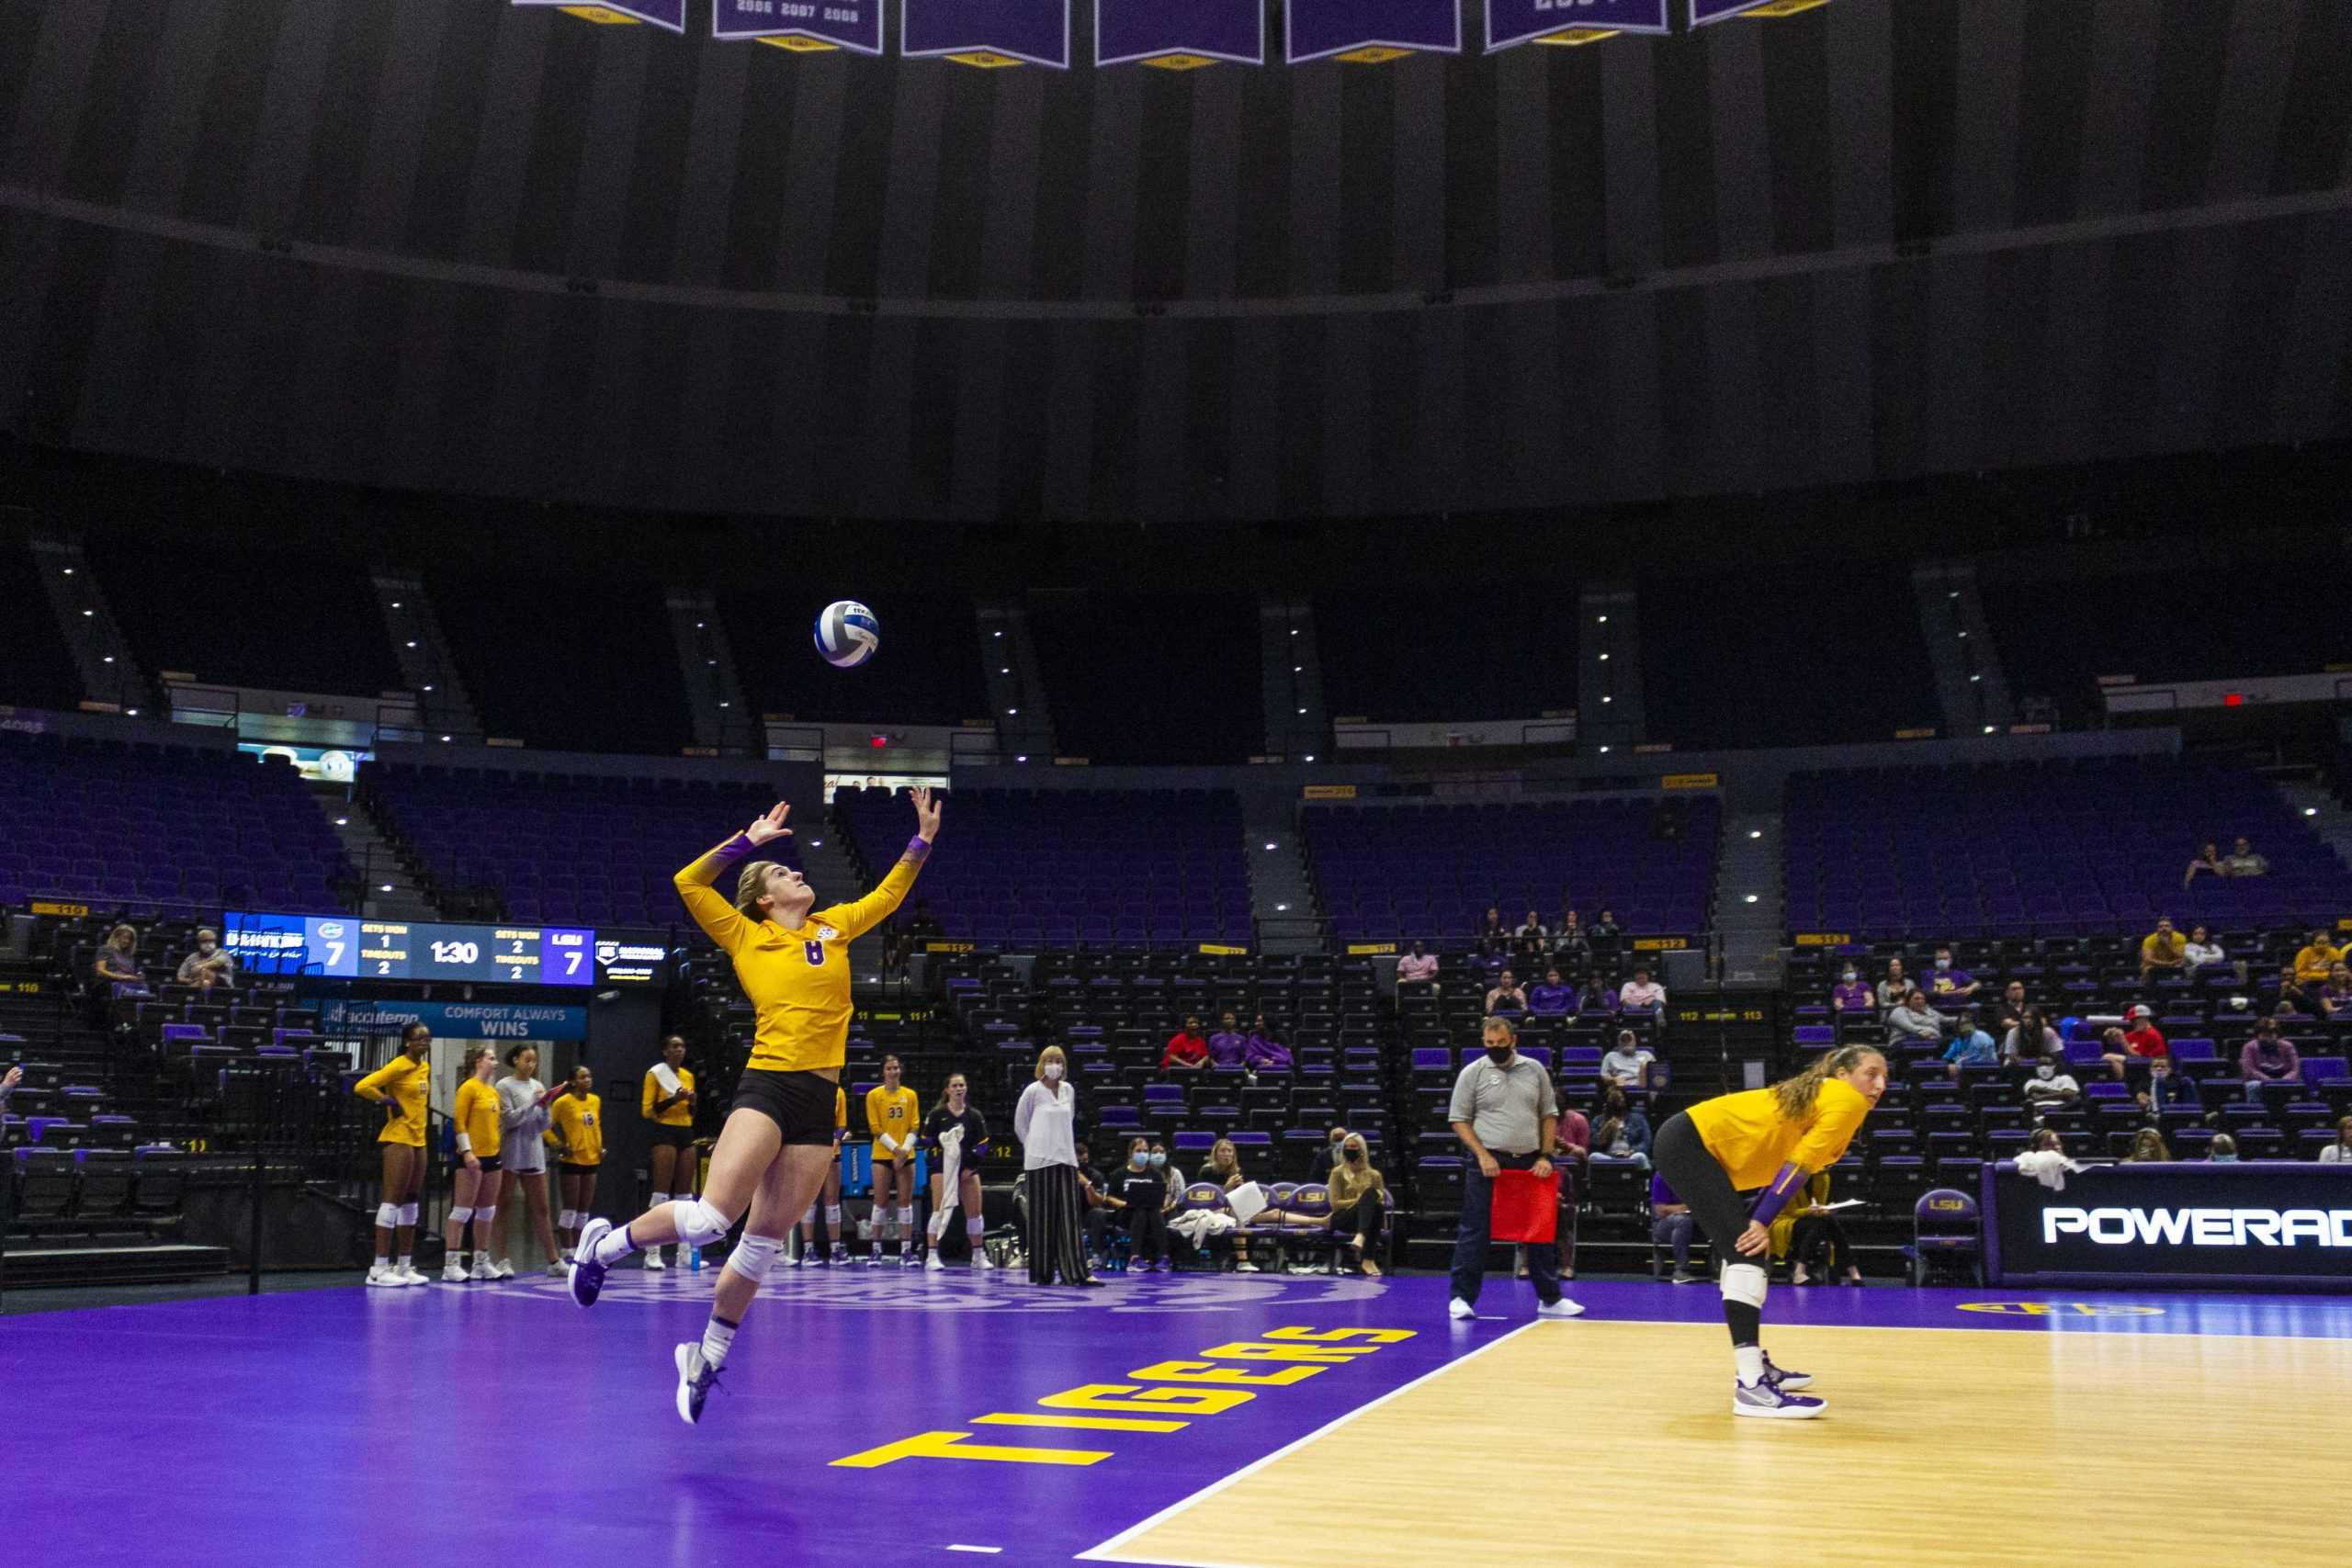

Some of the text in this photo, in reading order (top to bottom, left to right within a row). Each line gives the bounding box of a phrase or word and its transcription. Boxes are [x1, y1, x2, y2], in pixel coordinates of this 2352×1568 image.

[781, 3, 816, 17] 2007
[380, 934, 390, 948] 1
[551, 934, 582, 945] LSU
[325, 942, 345, 966] 7
[430, 941, 479, 964] 1:30
[512, 941, 524, 953] 2
[804, 940, 825, 967] 8
[378, 961, 390, 974] 2
[564, 952, 582, 975] 7
[511, 965, 523, 979] 2
[445, 1006, 566, 1021] COMFORT ALWAYS
[481, 1021, 529, 1036] WINS
[888, 1105, 905, 1119] 33
[1187, 1190, 1215, 1201] LSU
[1297, 1191, 1325, 1202] LSU
[1928, 1199, 1963, 1211] LSU
[828, 1325, 1417, 1467] TIGERS
